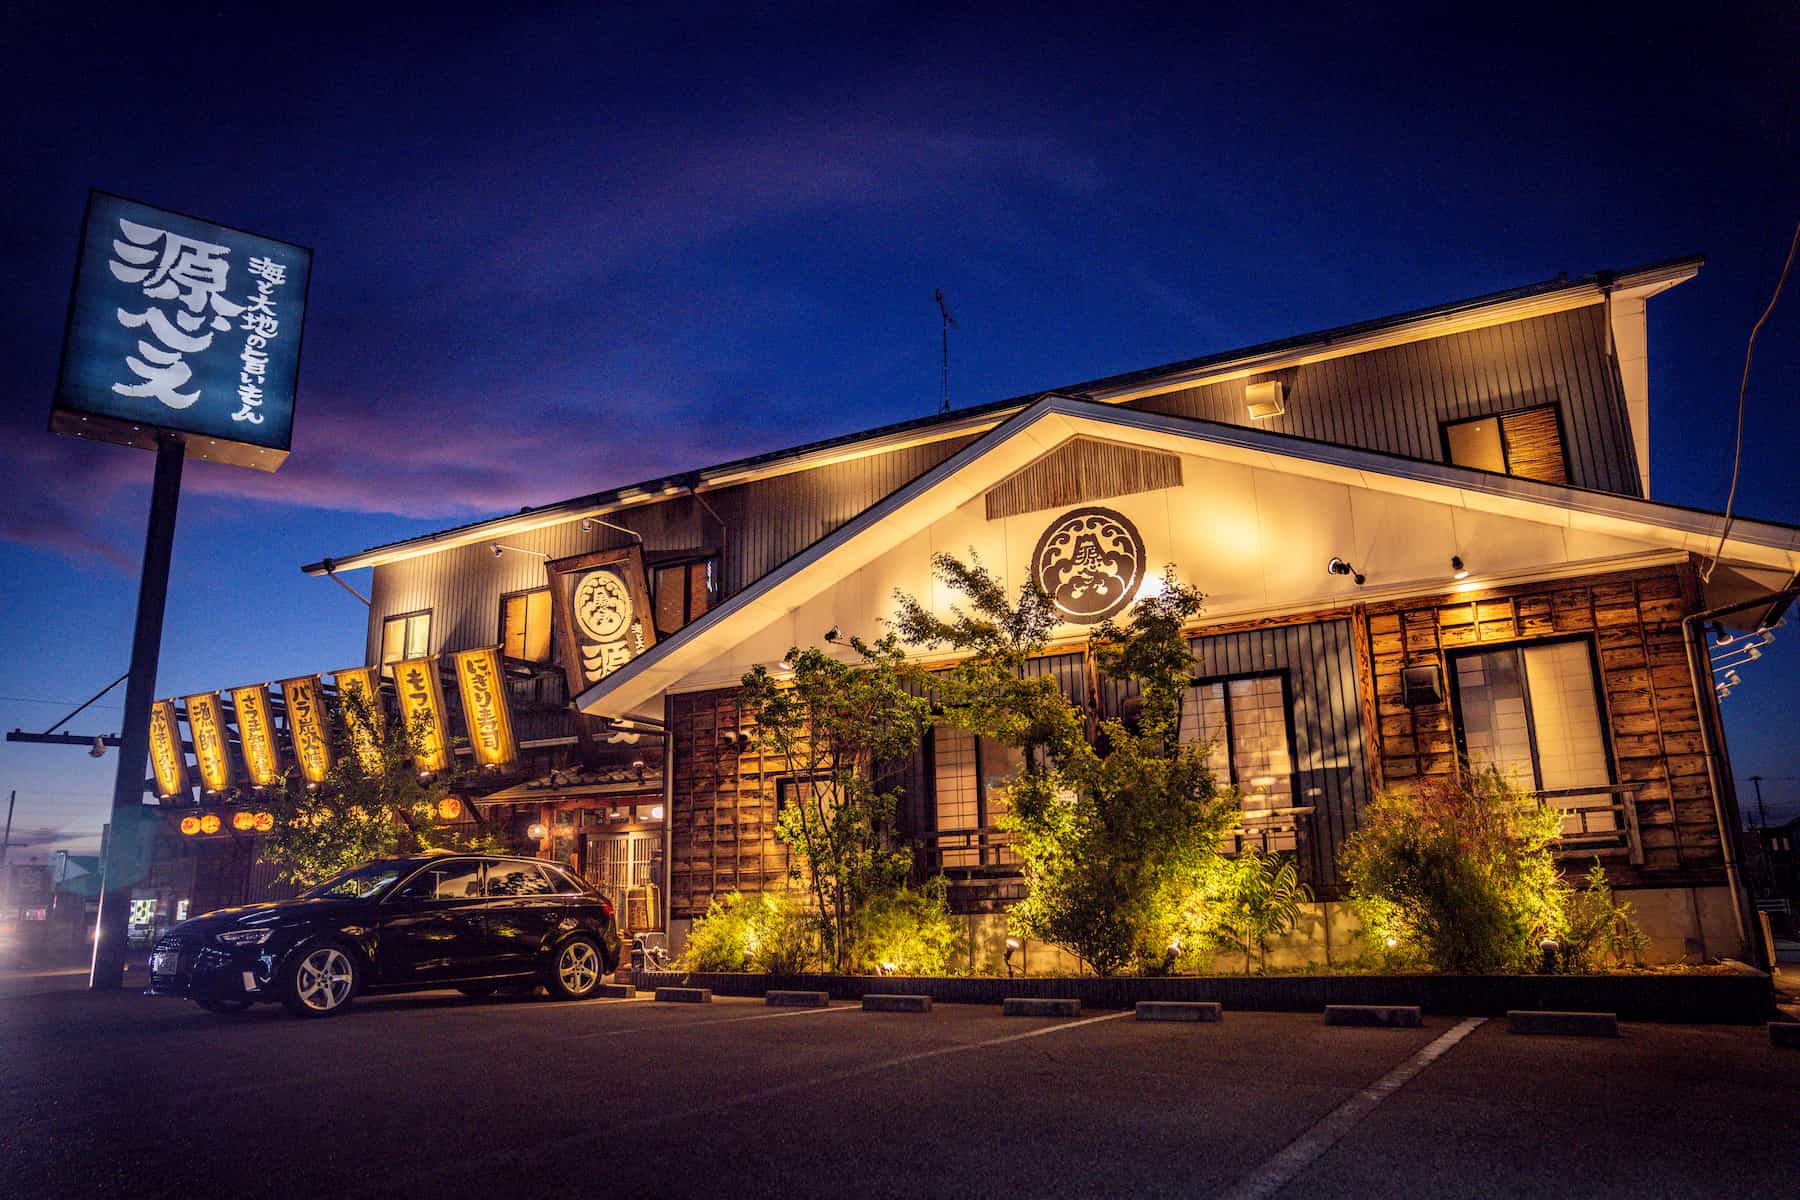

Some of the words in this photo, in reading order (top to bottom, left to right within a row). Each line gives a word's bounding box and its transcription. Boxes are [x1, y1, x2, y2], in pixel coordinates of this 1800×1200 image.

[231, 256, 287, 424] 海と大地の旨いもん
[466, 659, 499, 751] にぎり寿司
